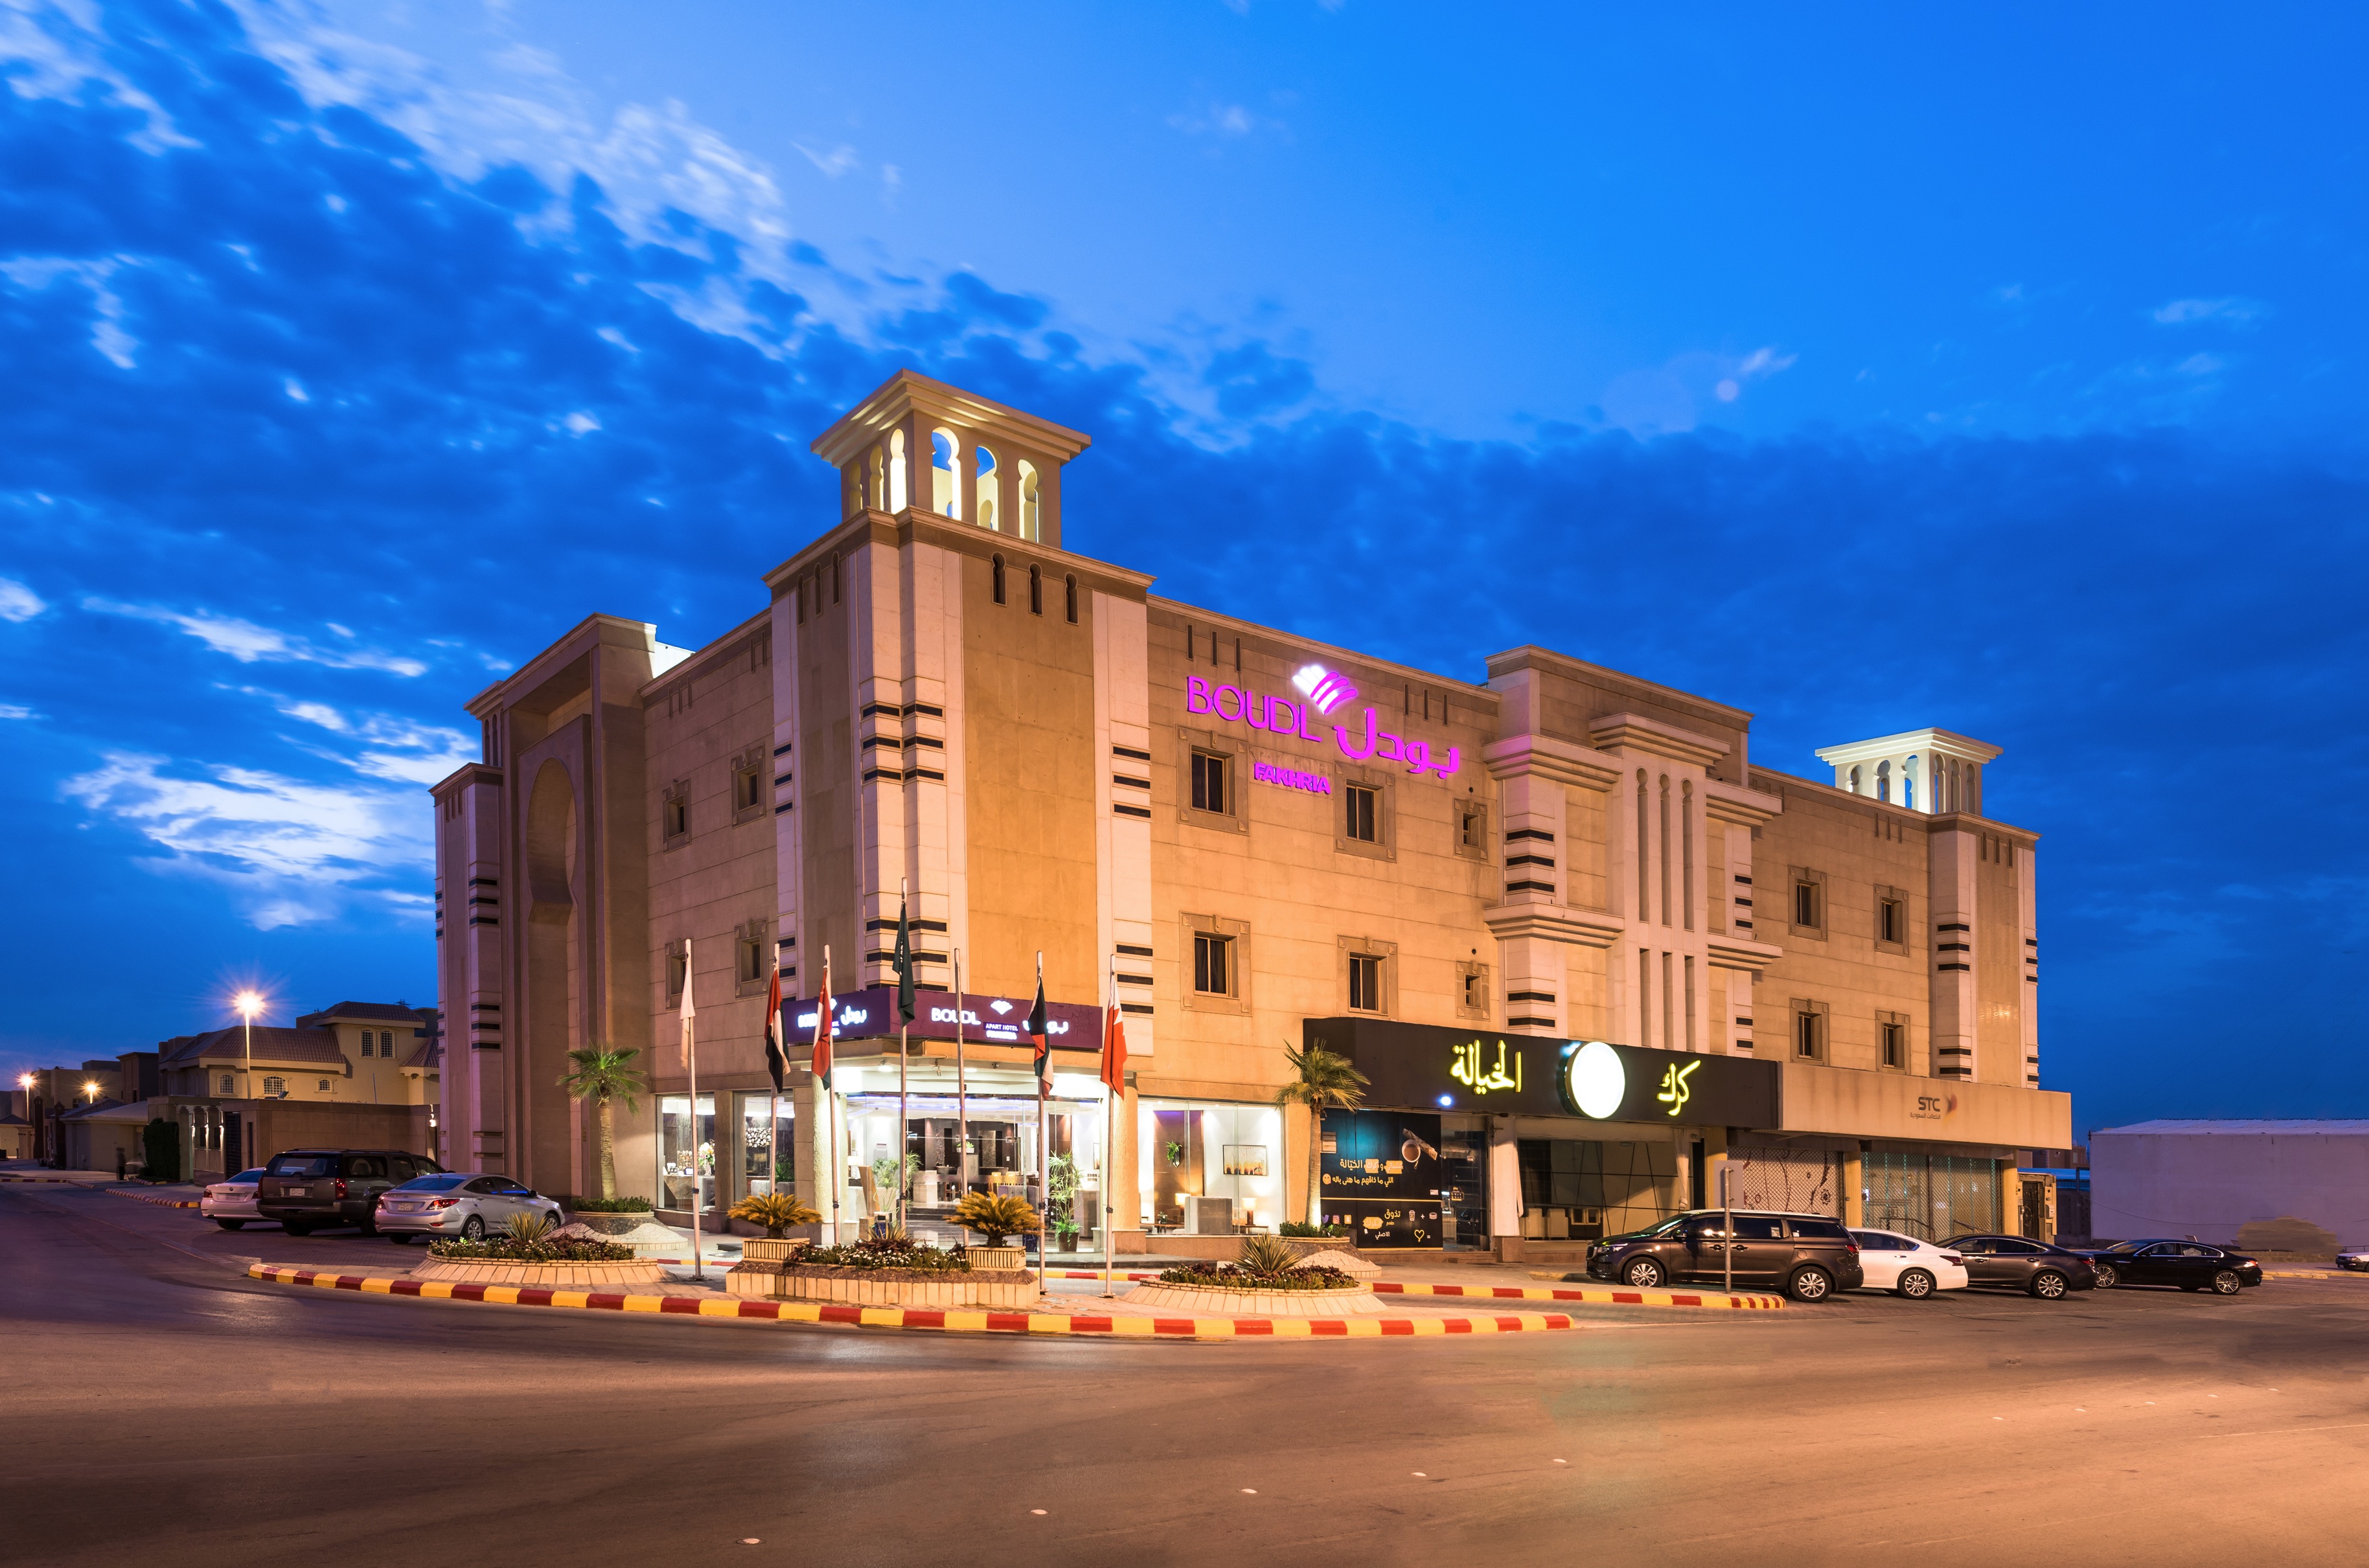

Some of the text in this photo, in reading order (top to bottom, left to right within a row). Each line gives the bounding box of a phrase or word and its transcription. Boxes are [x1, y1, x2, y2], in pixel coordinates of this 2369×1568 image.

[1186, 675, 1323, 742] BOUDL
[1333, 707, 1459, 779] بودل
[1254, 762, 1331, 795] FAKHRIA
[1450, 1038, 1701, 1116] كرك الخيالة
[1918, 1096, 1941, 1112] STC
[1354, 1176, 1360, 1185] ما
[1377, 1176, 1384, 1185] ما
[1384, 1176, 1394, 1187] اللي
[1384, 1209, 1401, 1220] تذوق
